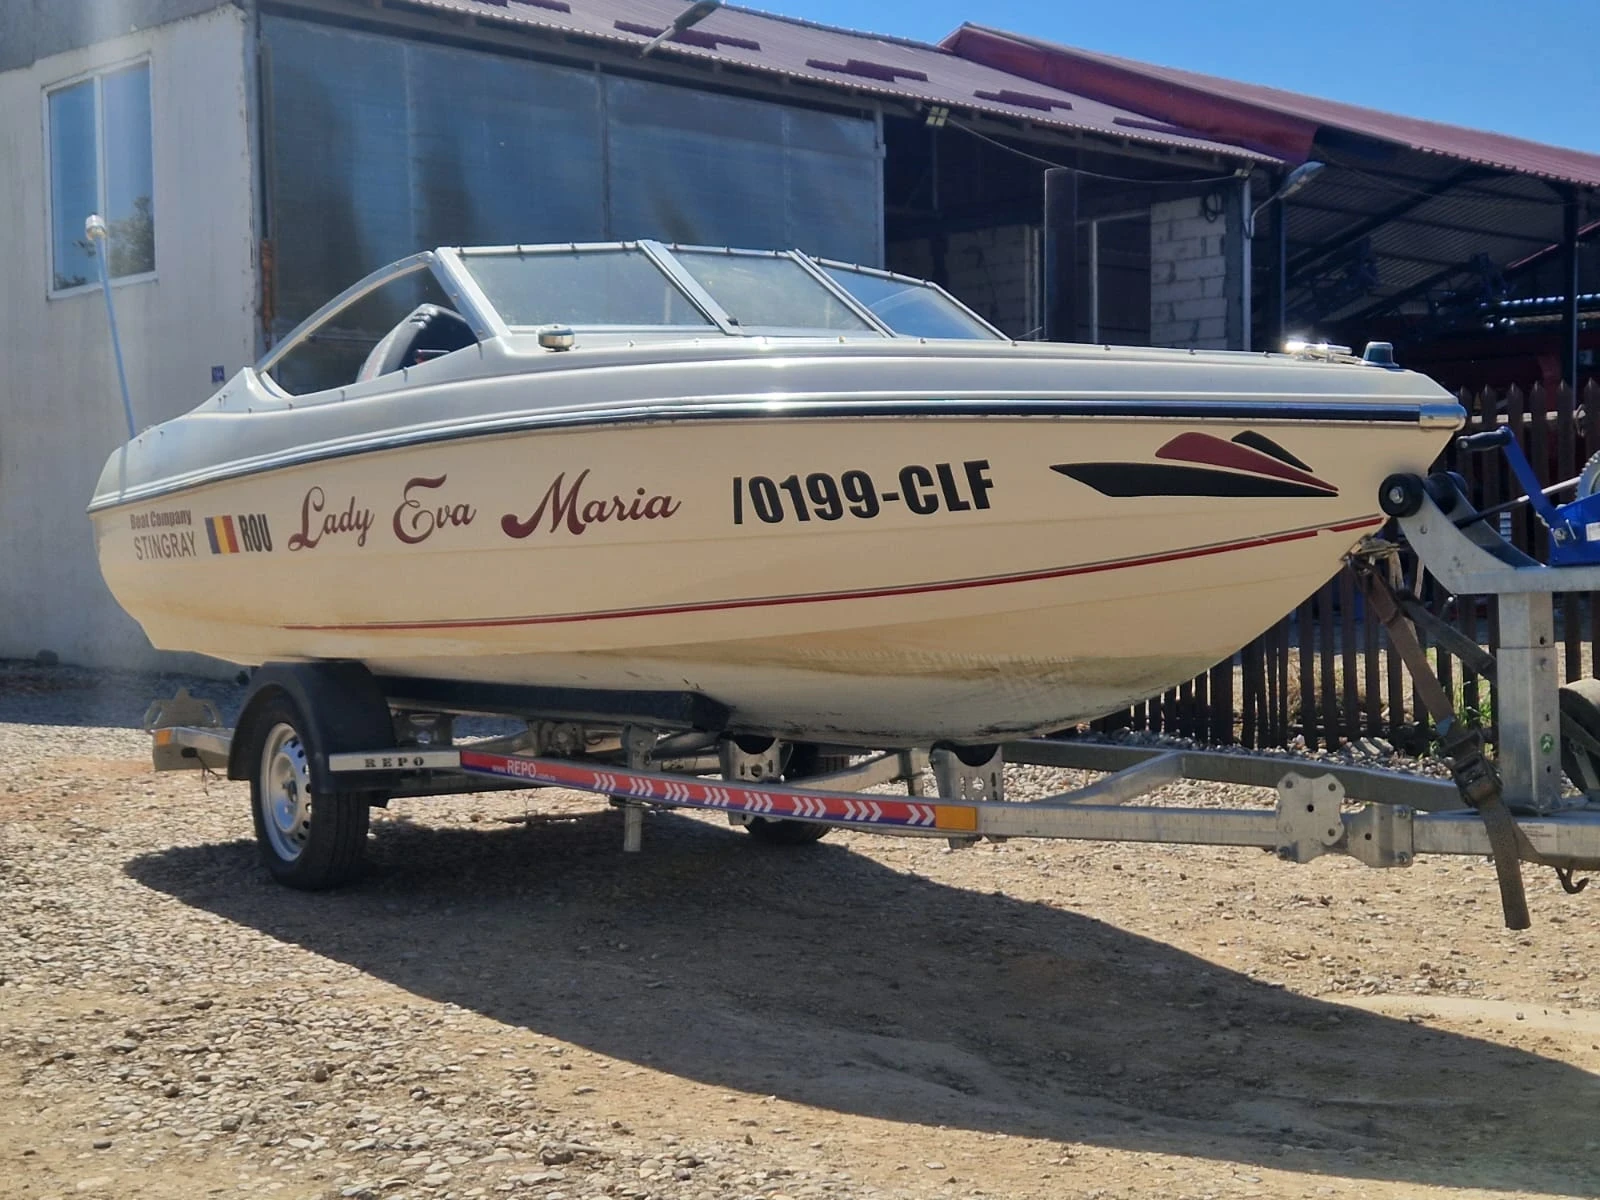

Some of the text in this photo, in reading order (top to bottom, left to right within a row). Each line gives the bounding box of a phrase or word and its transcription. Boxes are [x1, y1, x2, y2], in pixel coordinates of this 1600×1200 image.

[130, 509, 192, 530] Boat Company
[287, 468, 682, 551] Lady Eva Maria
[133, 530, 197, 560] STINGRAY
[237, 513, 273, 552] ROU
[364, 756, 425, 768] REPO
